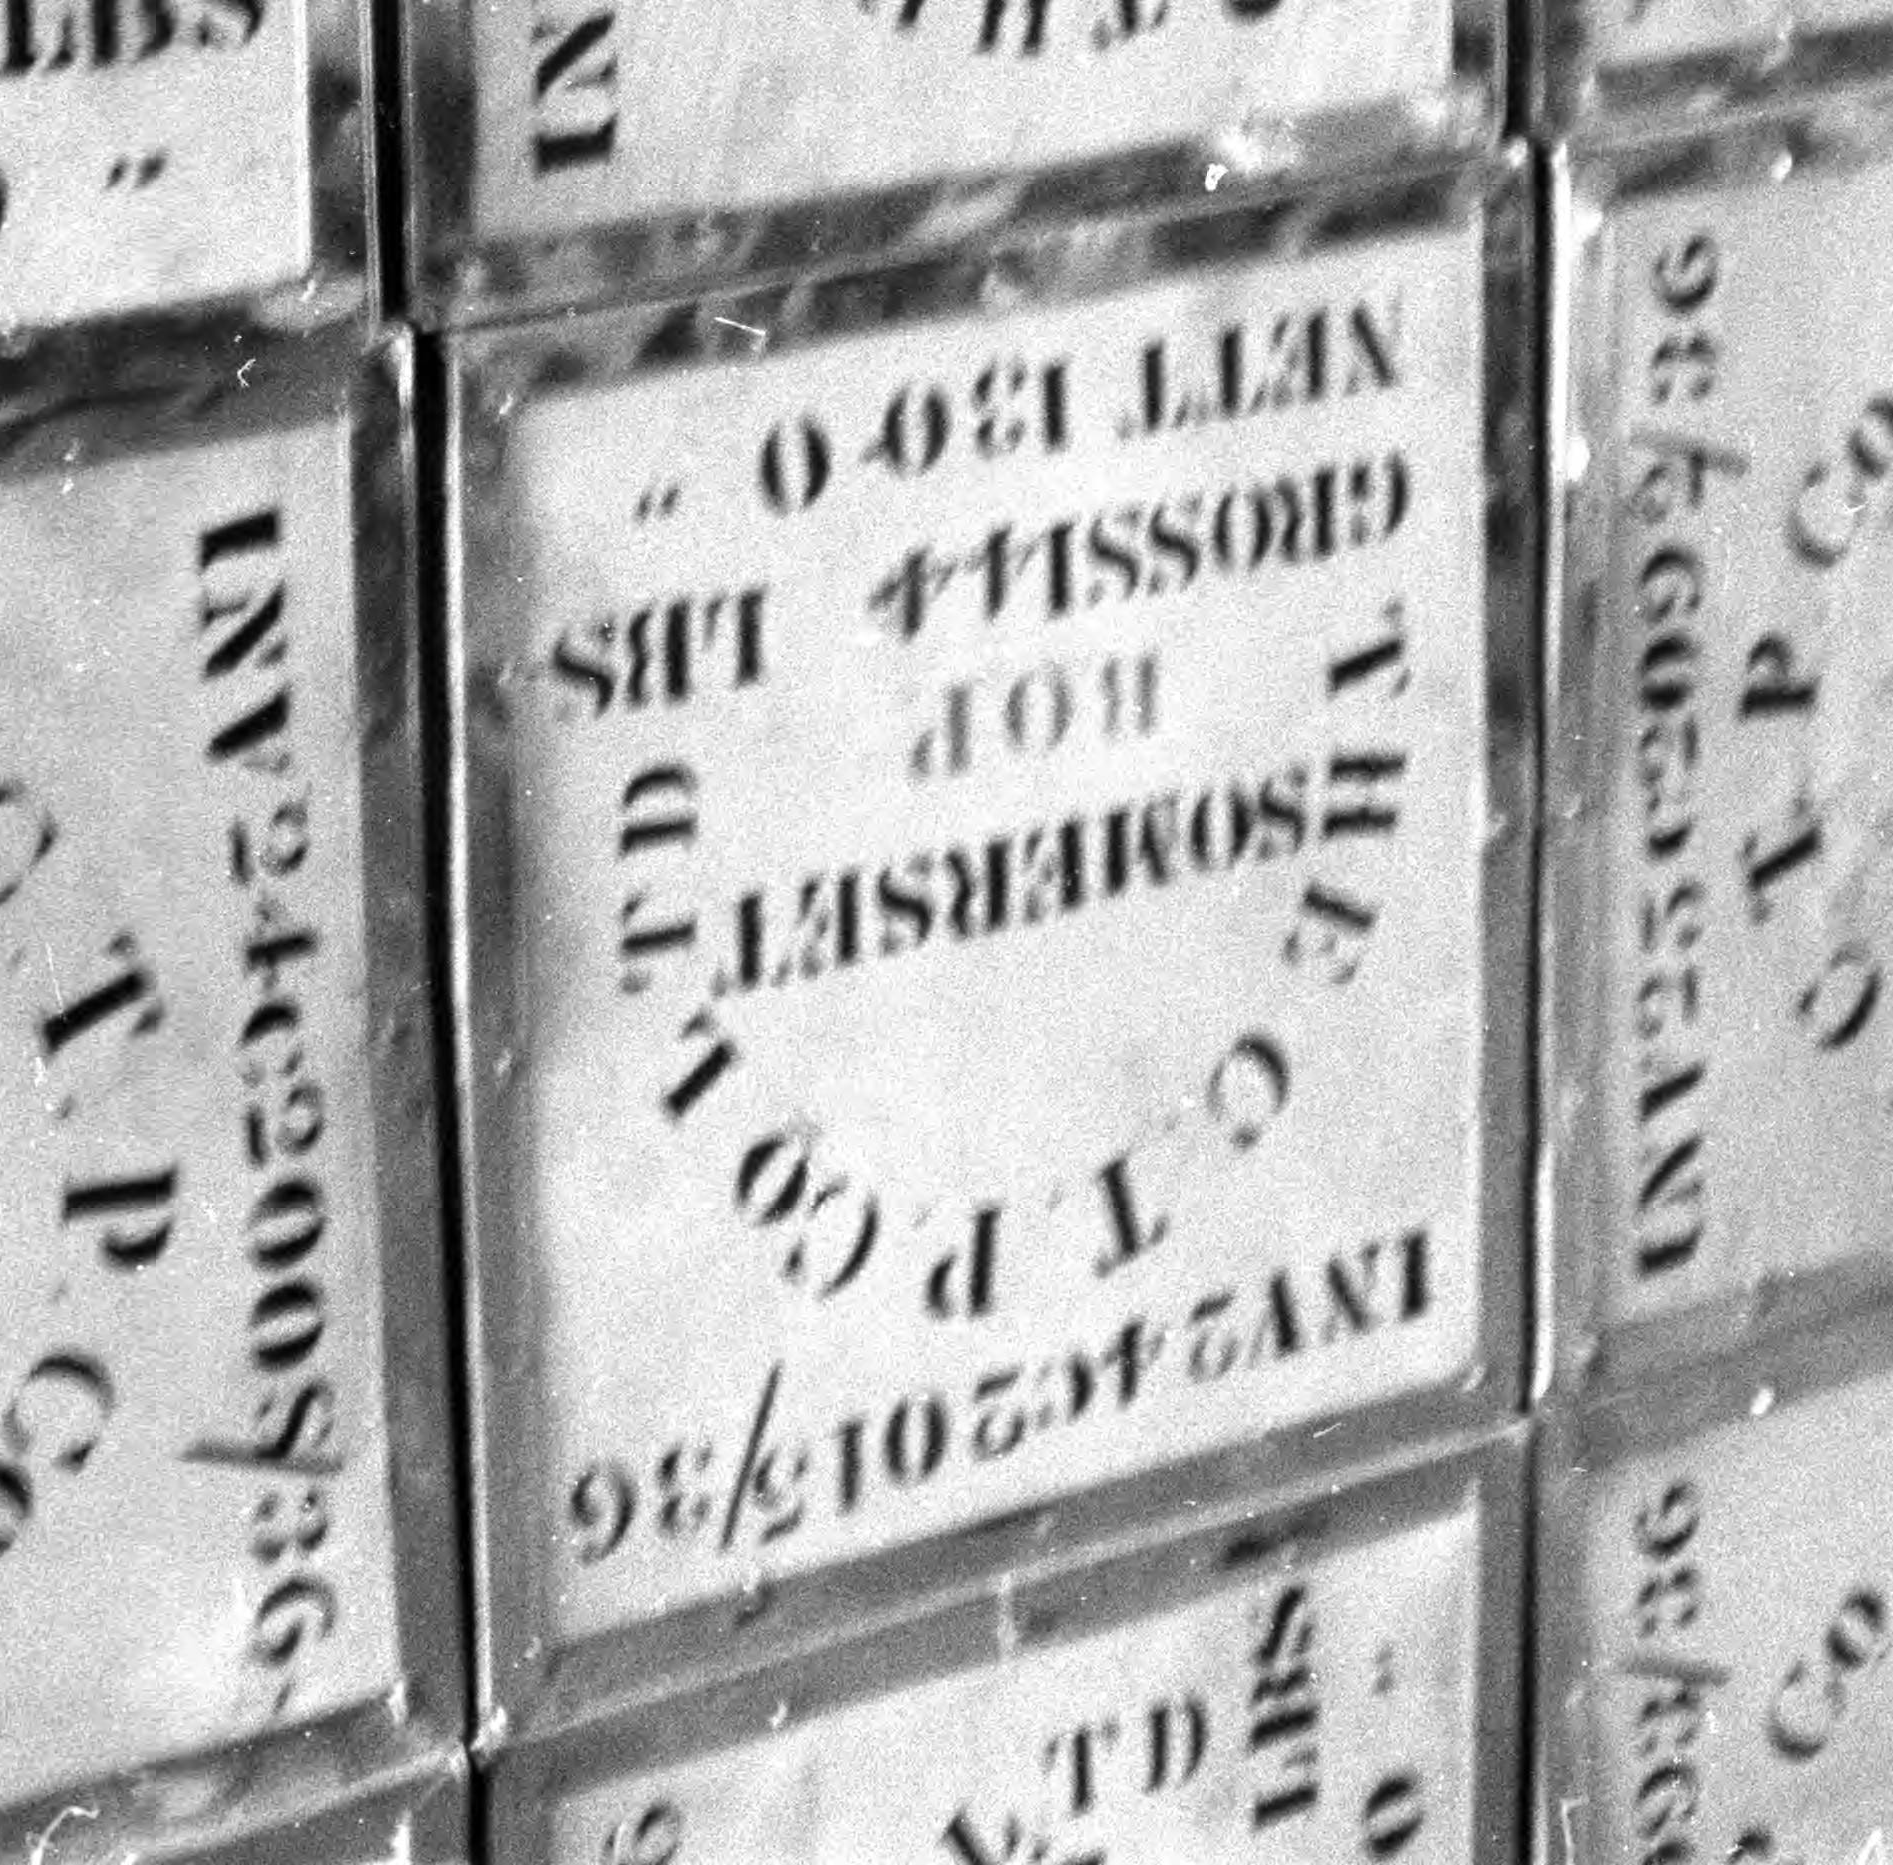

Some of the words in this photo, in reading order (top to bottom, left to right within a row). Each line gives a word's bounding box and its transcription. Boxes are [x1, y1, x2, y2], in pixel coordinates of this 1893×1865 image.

[1115, 303, 1397, 434] NETT
[543, 588, 773, 719] LBS
[715, 763, 1313, 999] SOMERSET
